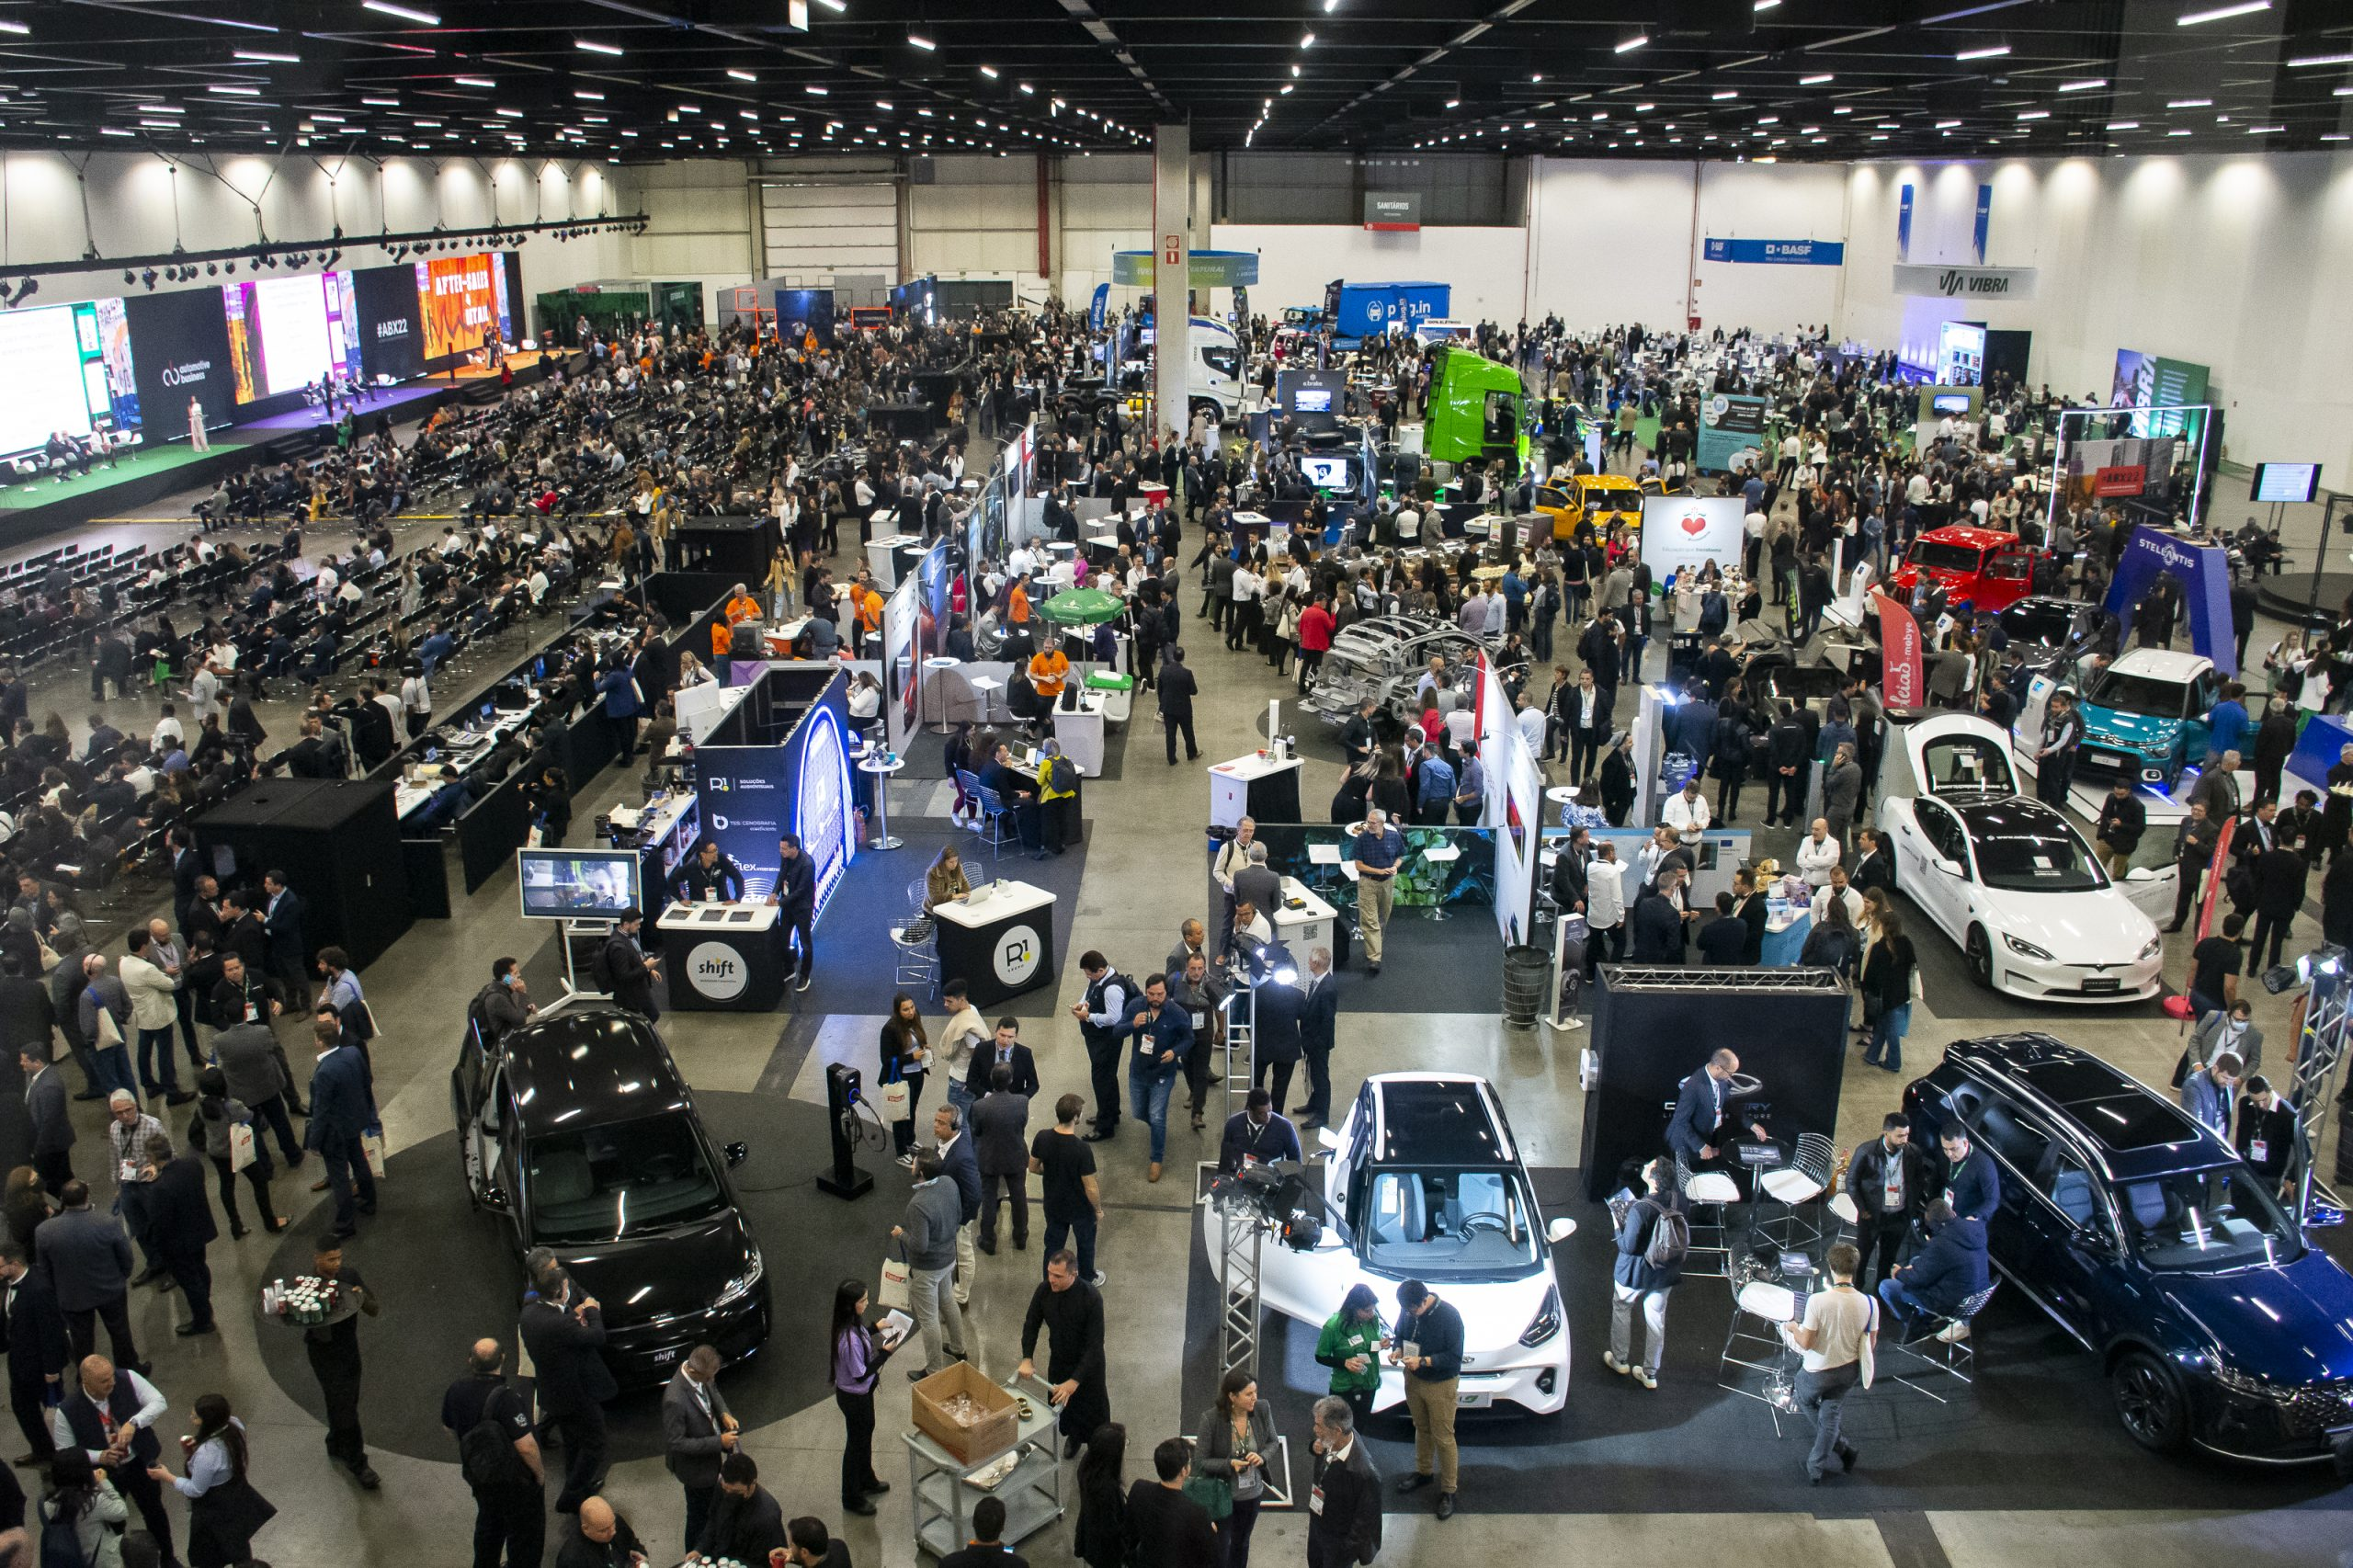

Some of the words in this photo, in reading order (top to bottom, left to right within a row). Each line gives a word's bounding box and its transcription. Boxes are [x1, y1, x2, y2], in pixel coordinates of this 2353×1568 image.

[1377, 200, 1409, 210] SANITÁRIOS
[1781, 244, 1812, 256] BASF
[1969, 277, 2009, 292] VIBRA
[378, 318, 408, 338] #ABX22
[2139, 539, 2196, 569] STELLANTIS
[699, 957, 734, 978] shift
[654, 1350, 676, 1362] shift
